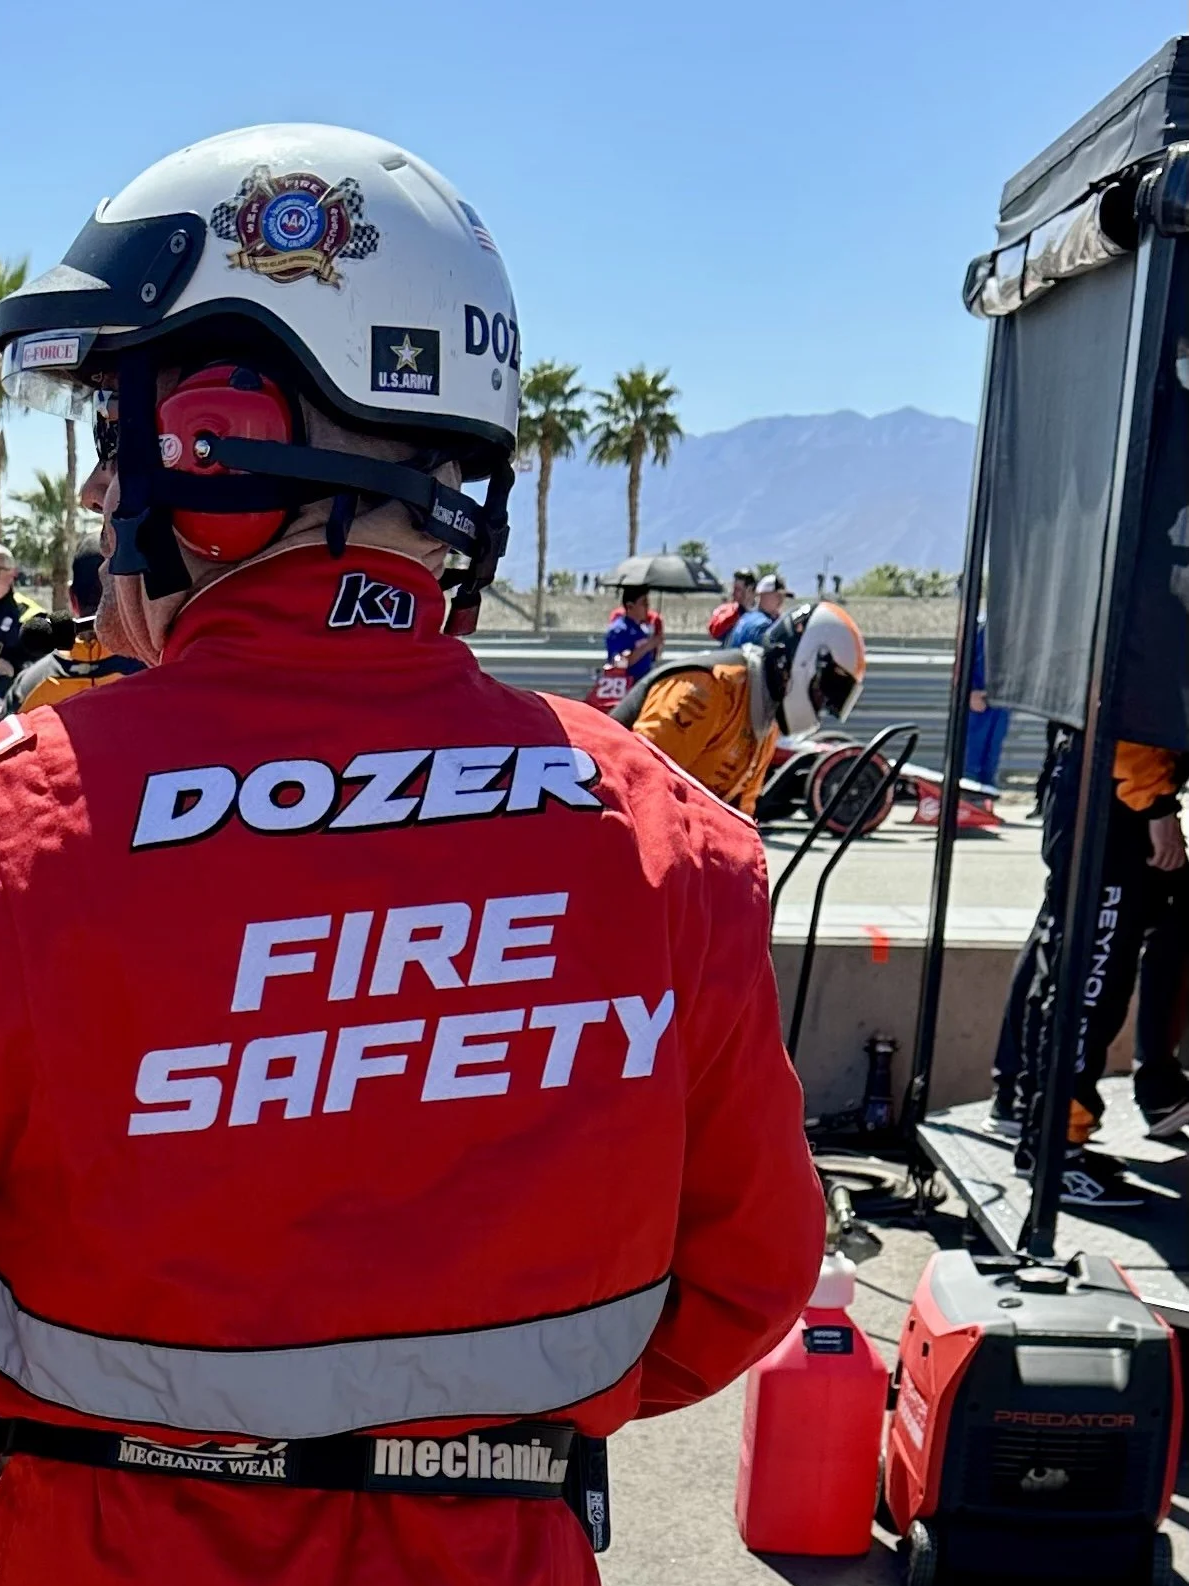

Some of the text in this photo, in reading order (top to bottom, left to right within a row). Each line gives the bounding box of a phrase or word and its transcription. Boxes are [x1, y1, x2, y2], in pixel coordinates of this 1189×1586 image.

[284, 179, 321, 193] FIRE
[246, 203, 259, 234] EMS
[281, 213, 306, 228] AAA
[323, 207, 339, 252] RESCUE
[24, 343, 74, 362] G-FORCE
[464, 303, 521, 372] DOZ
[328, 573, 415, 629] K1
[596, 677, 628, 698] 28
[129, 745, 605, 852] DOZER
[230, 891, 569, 1013] FIRE
[127, 989, 675, 1136] SAFETY
[993, 1409, 1137, 1428] PREDATOR
[118, 1442, 287, 1479] MECHANIX WEAR
